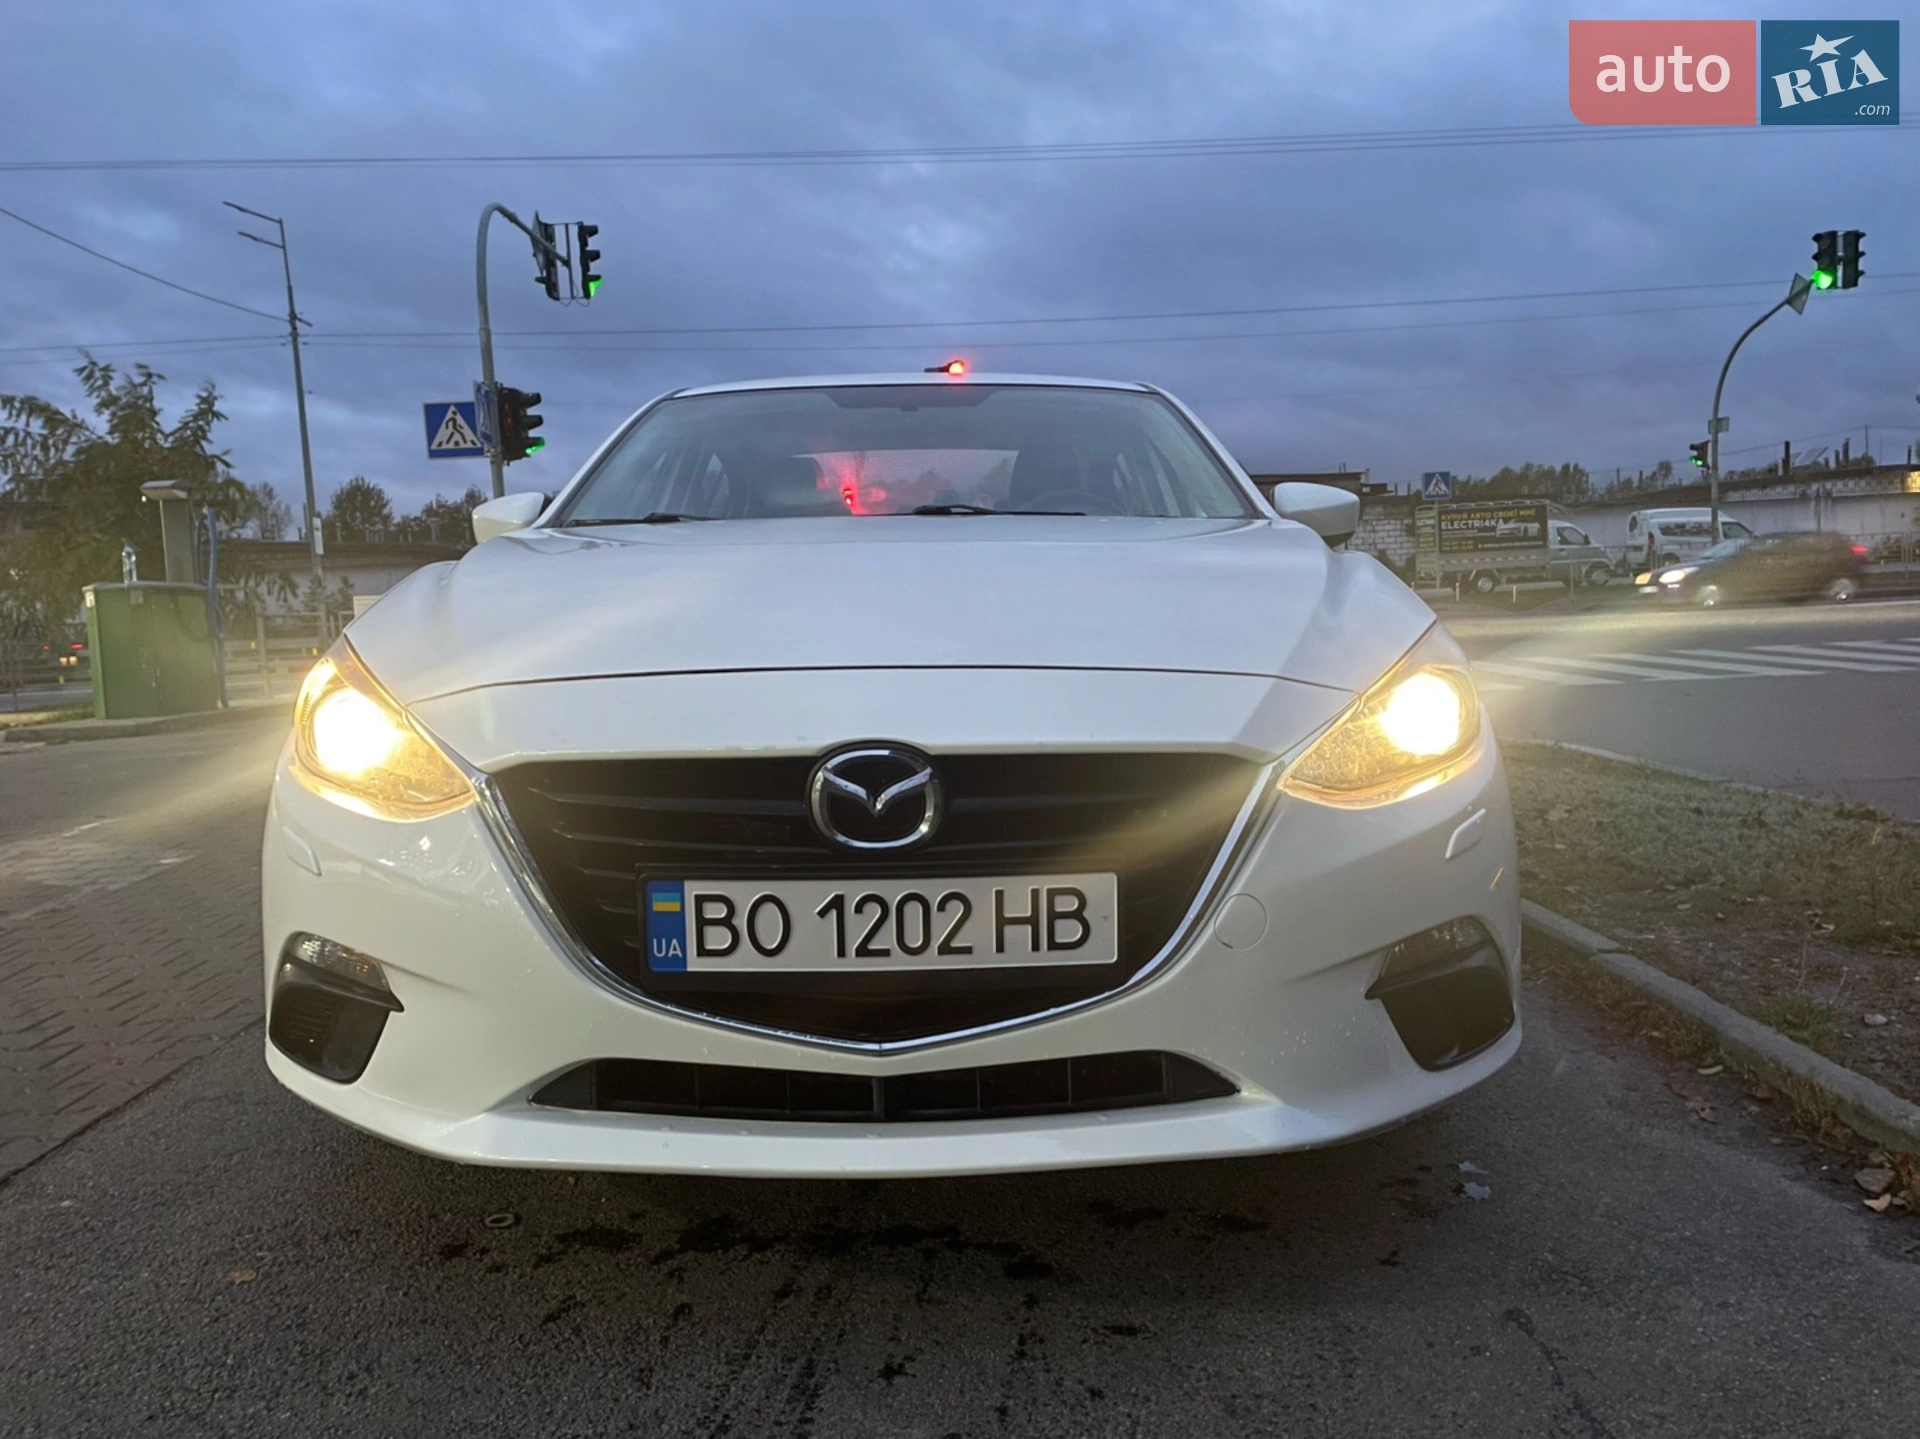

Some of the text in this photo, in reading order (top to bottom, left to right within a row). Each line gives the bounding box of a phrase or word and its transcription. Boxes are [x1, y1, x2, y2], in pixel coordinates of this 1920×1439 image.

[1470, 511, 1491, 519] АВТО
[693, 886, 1091, 958] BO 1202 HB
[652, 938, 682, 958] UA
